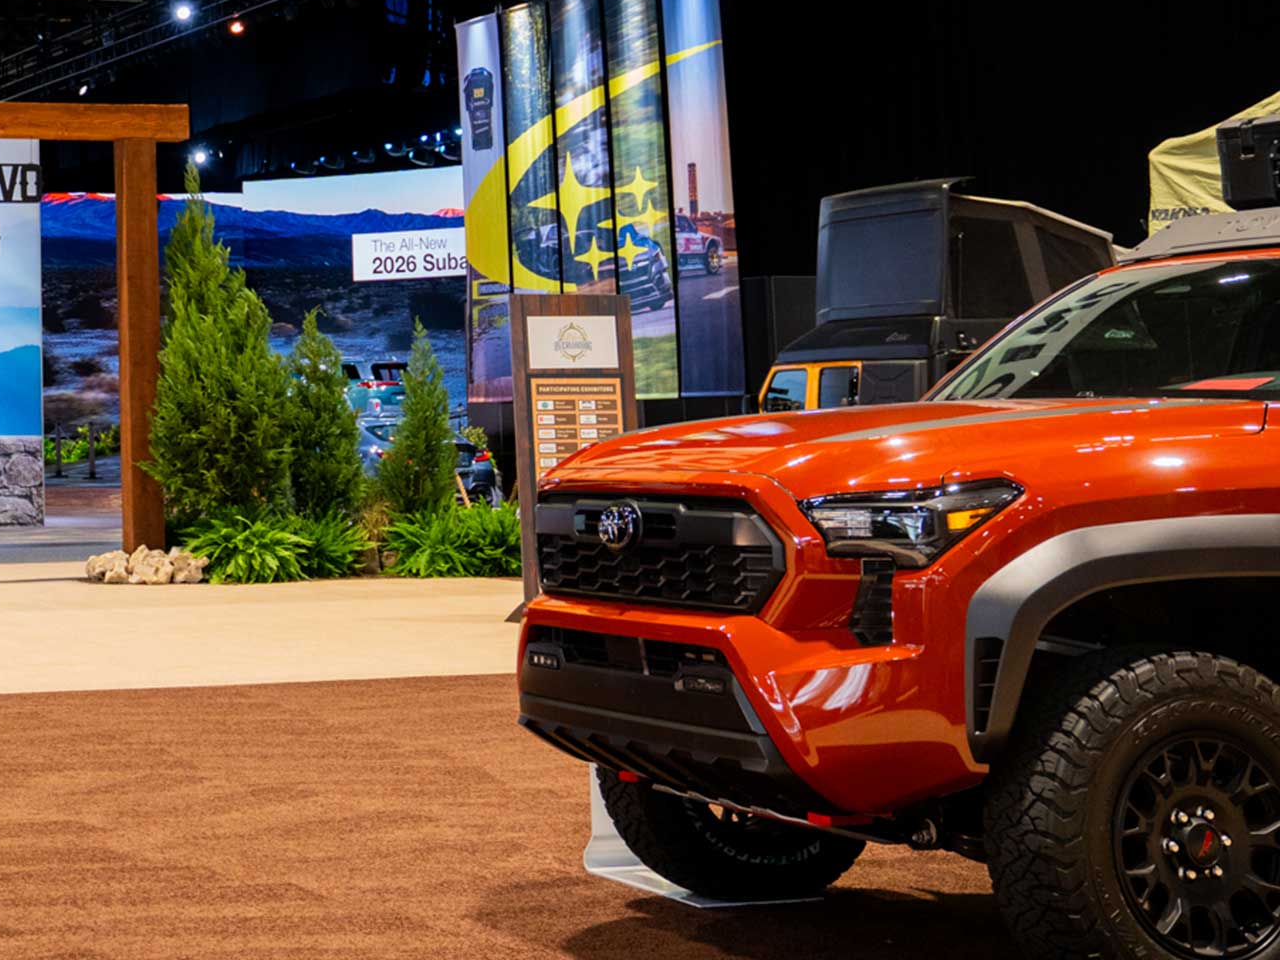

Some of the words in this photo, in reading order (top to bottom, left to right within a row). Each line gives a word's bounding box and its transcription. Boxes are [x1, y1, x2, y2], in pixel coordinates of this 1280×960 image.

[372, 239, 395, 253] The
[400, 236, 447, 251] All-New
[372, 254, 417, 274] 2026
